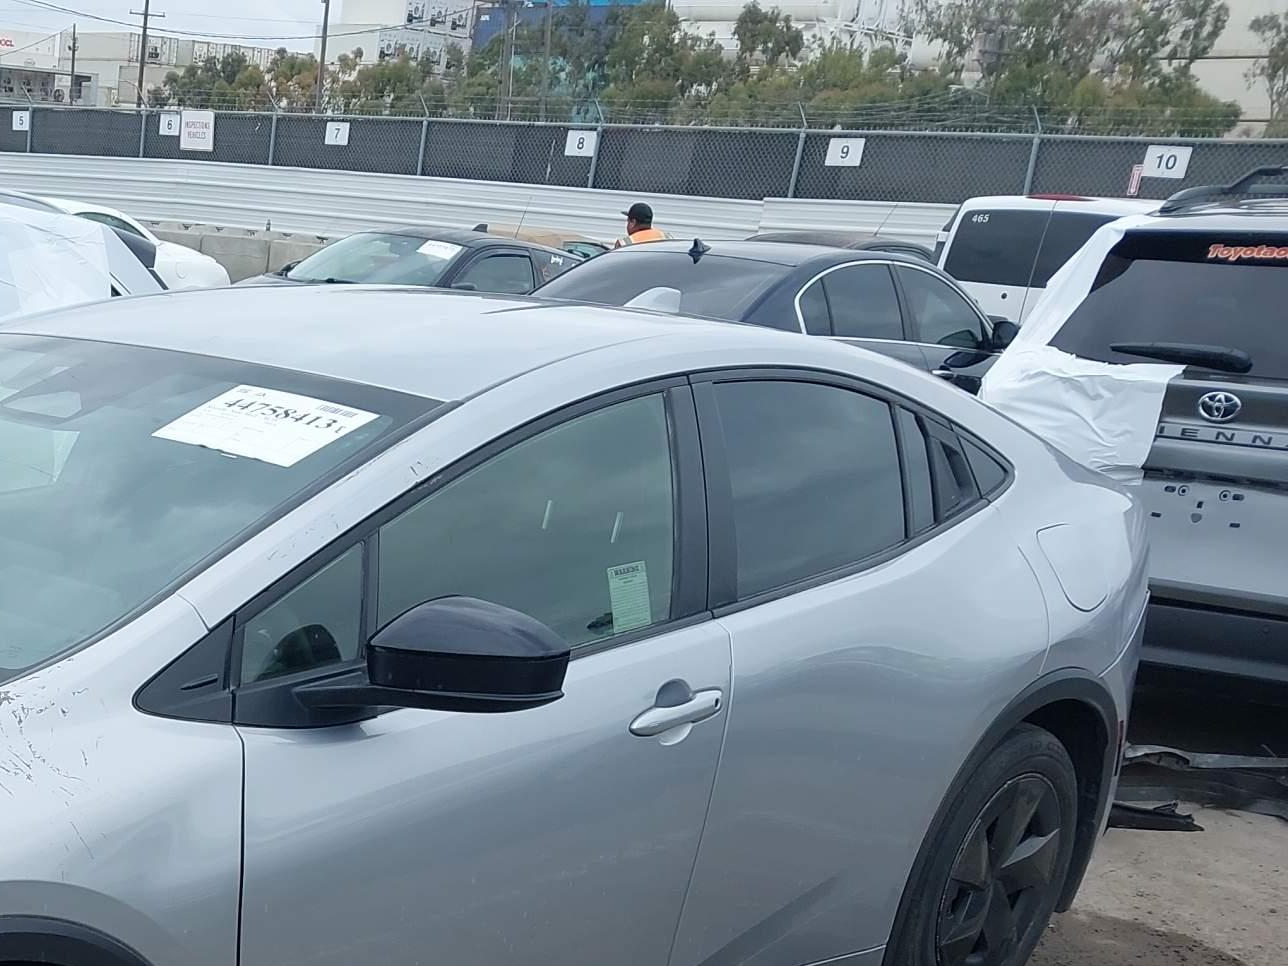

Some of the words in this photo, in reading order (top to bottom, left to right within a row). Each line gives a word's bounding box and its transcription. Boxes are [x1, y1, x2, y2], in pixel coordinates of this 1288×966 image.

[18, 116, 24, 126] 5
[167, 120, 172, 130] 6
[334, 127, 341, 140] 7
[577, 137, 585, 150] 8
[840, 145, 850, 159] 9
[1156, 153, 1177, 170] 10
[972, 214, 990, 223] 465
[223, 399, 338, 429] 44758413
[1158, 425, 1288, 447] IENN
